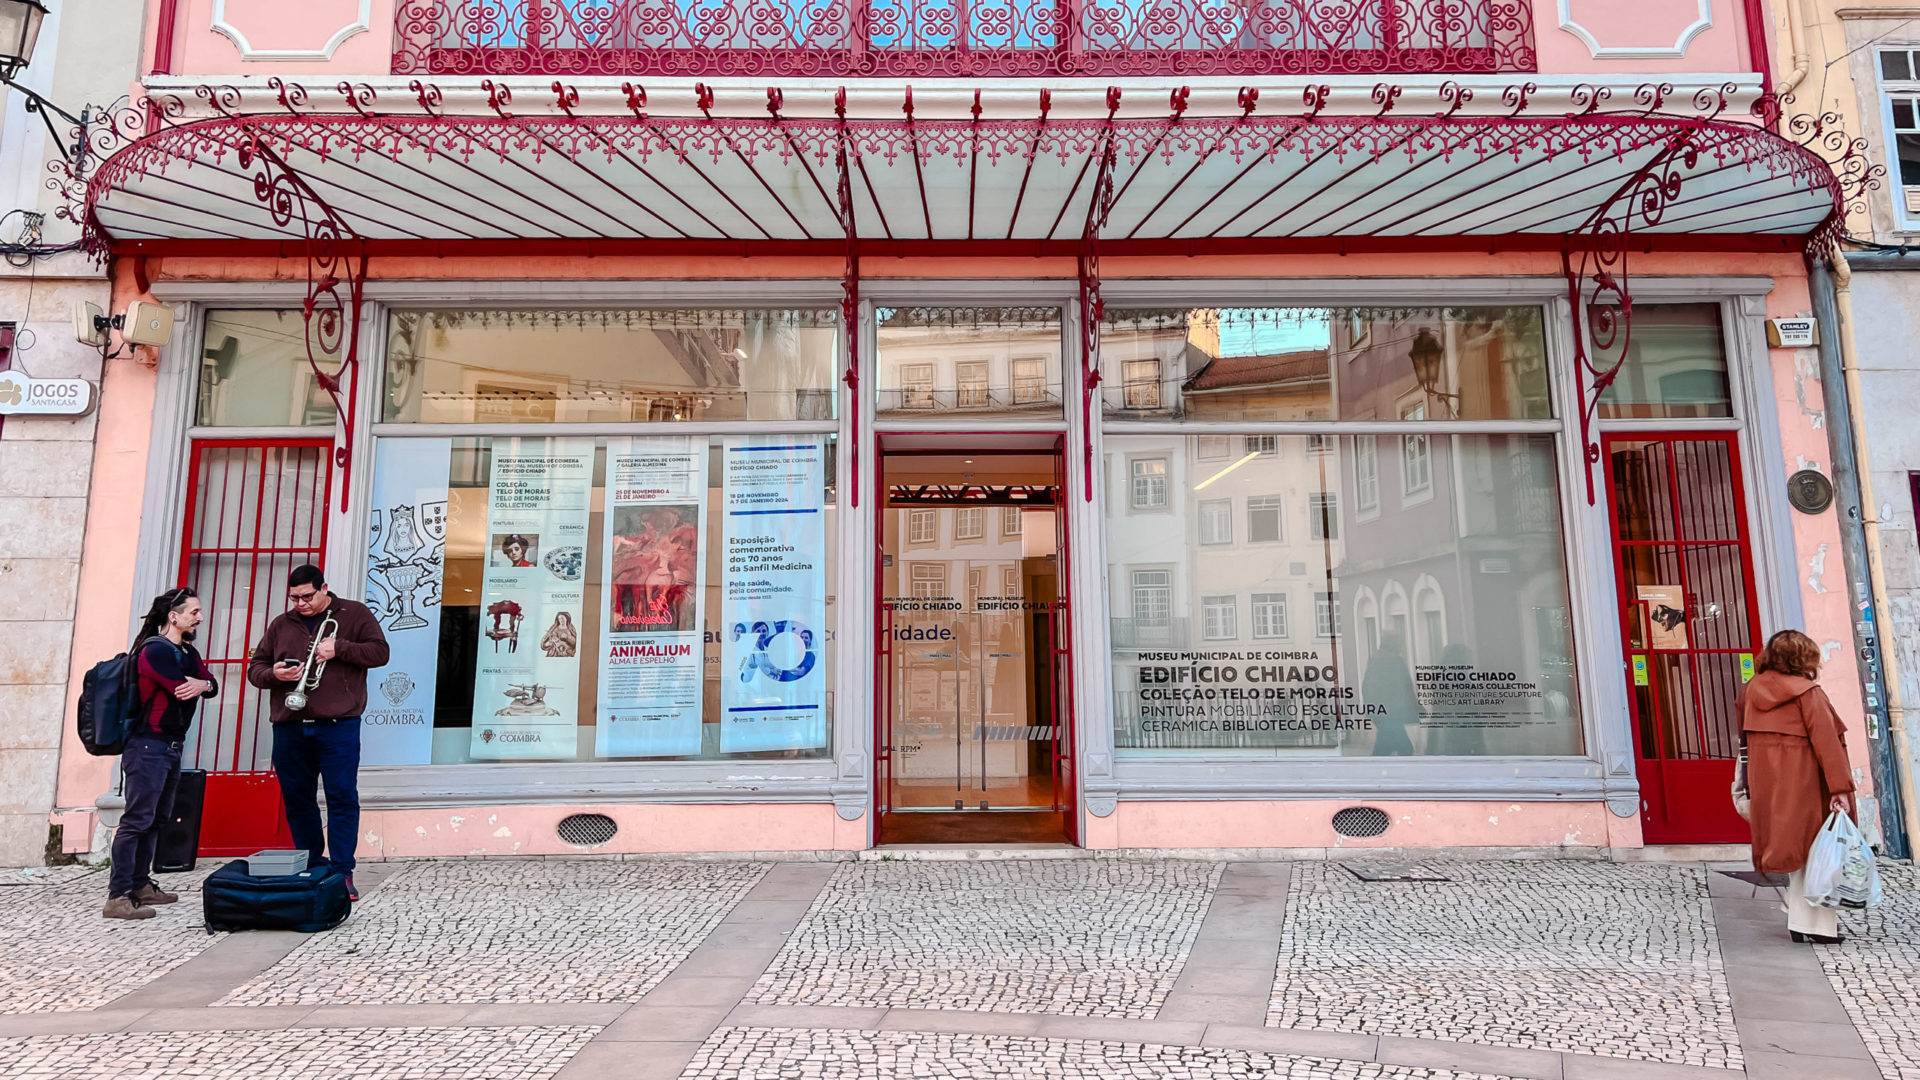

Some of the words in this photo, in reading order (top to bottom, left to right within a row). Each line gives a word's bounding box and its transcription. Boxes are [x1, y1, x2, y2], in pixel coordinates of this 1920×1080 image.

[26, 384, 78, 402] JOGOS
[730, 536, 776, 545] Exposição
[730, 544, 794, 553] comemorativa
[743, 564, 769, 572] Sanfil
[772, 562, 812, 570] Medicina
[978, 601, 1019, 610] EDIFÍCIO
[610, 644, 690, 658] ANIMALIUM
[1138, 652, 1178, 660] MUSEU
[1181, 652, 1244, 660] MUNICIPAL
[1247, 652, 1262, 660] DE
[1265, 652, 1318, 660] COIMBRA
[1140, 661, 1238, 683] EDIFÍCIO
[1245, 666, 1338, 682] CHIADO
[1416, 670, 1466, 681] EDIFÍCIO
[1469, 672, 1516, 681] CHIADO
[1140, 684, 1216, 704] COLEÇÃO
[1220, 688, 1259, 700] TELO
[1264, 688, 1286, 699] DE
[1290, 687, 1353, 699] MORAIS
[1142, 705, 1206, 716] PINTURA
[1210, 702, 1298, 716] MOBILIÁRIO
[1303, 704, 1387, 715] ESCULTURA
[365, 714, 424, 725] COIMBRA
[1142, 720, 1219, 732] CERAMICA
[1222, 720, 1307, 731] BIBLIOTECA
[1311, 720, 1330, 730] DE
[1335, 719, 1372, 730] ARTE
[500, 734, 542, 742] COIMBRA
